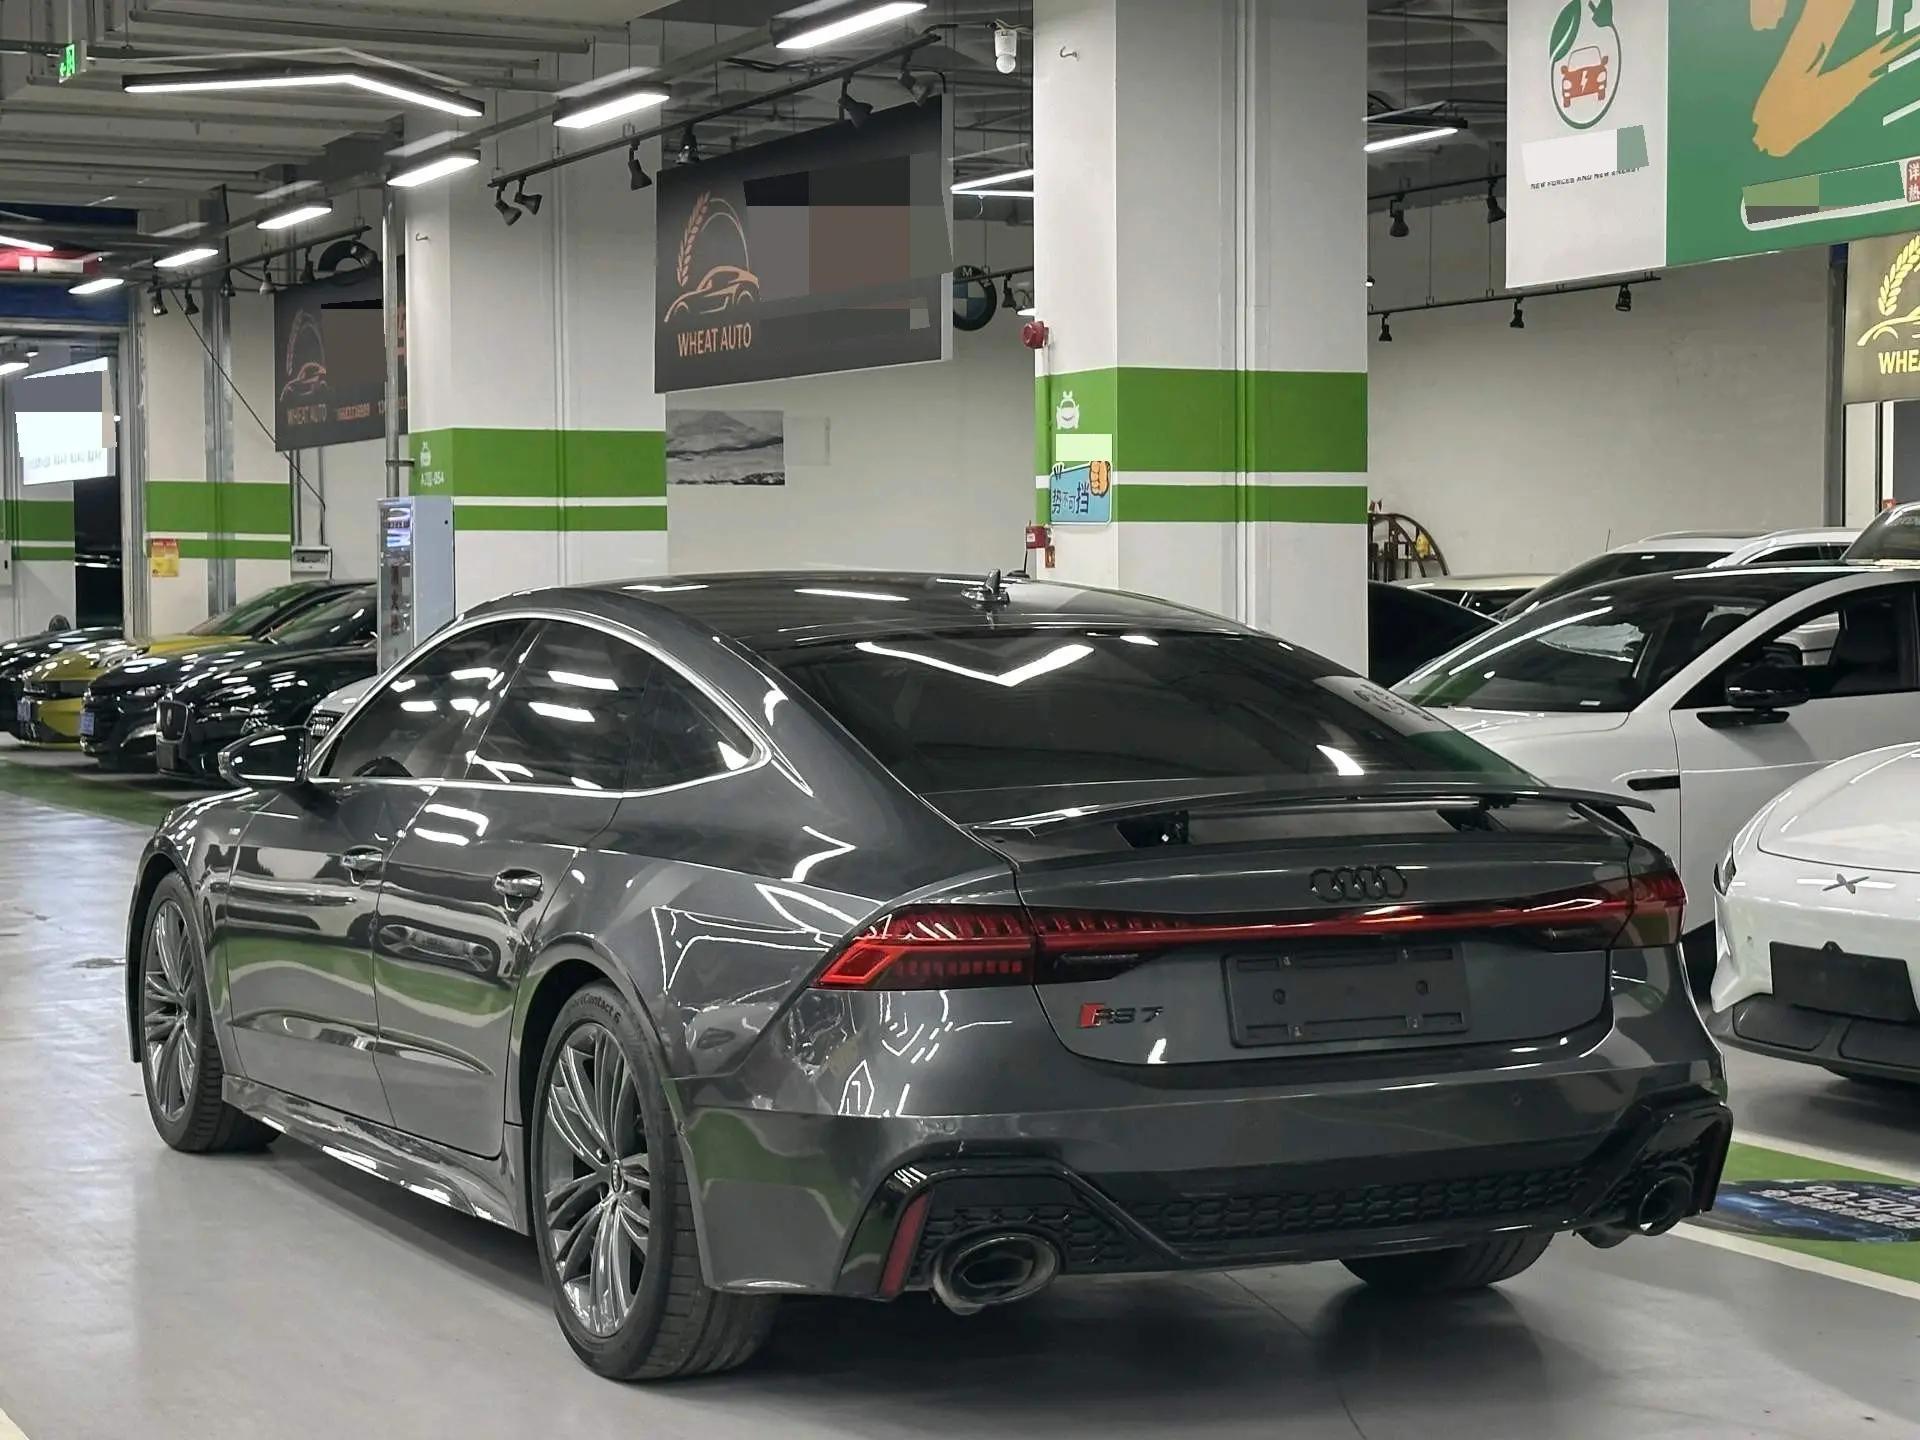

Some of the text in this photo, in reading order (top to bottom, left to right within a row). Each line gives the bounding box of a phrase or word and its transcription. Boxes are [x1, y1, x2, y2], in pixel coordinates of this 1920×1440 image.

[677, 321, 752, 357] WHEAT AUTO
[1877, 348, 1920, 375] WHE
[1052, 481, 1090, 514] 势不可挡
